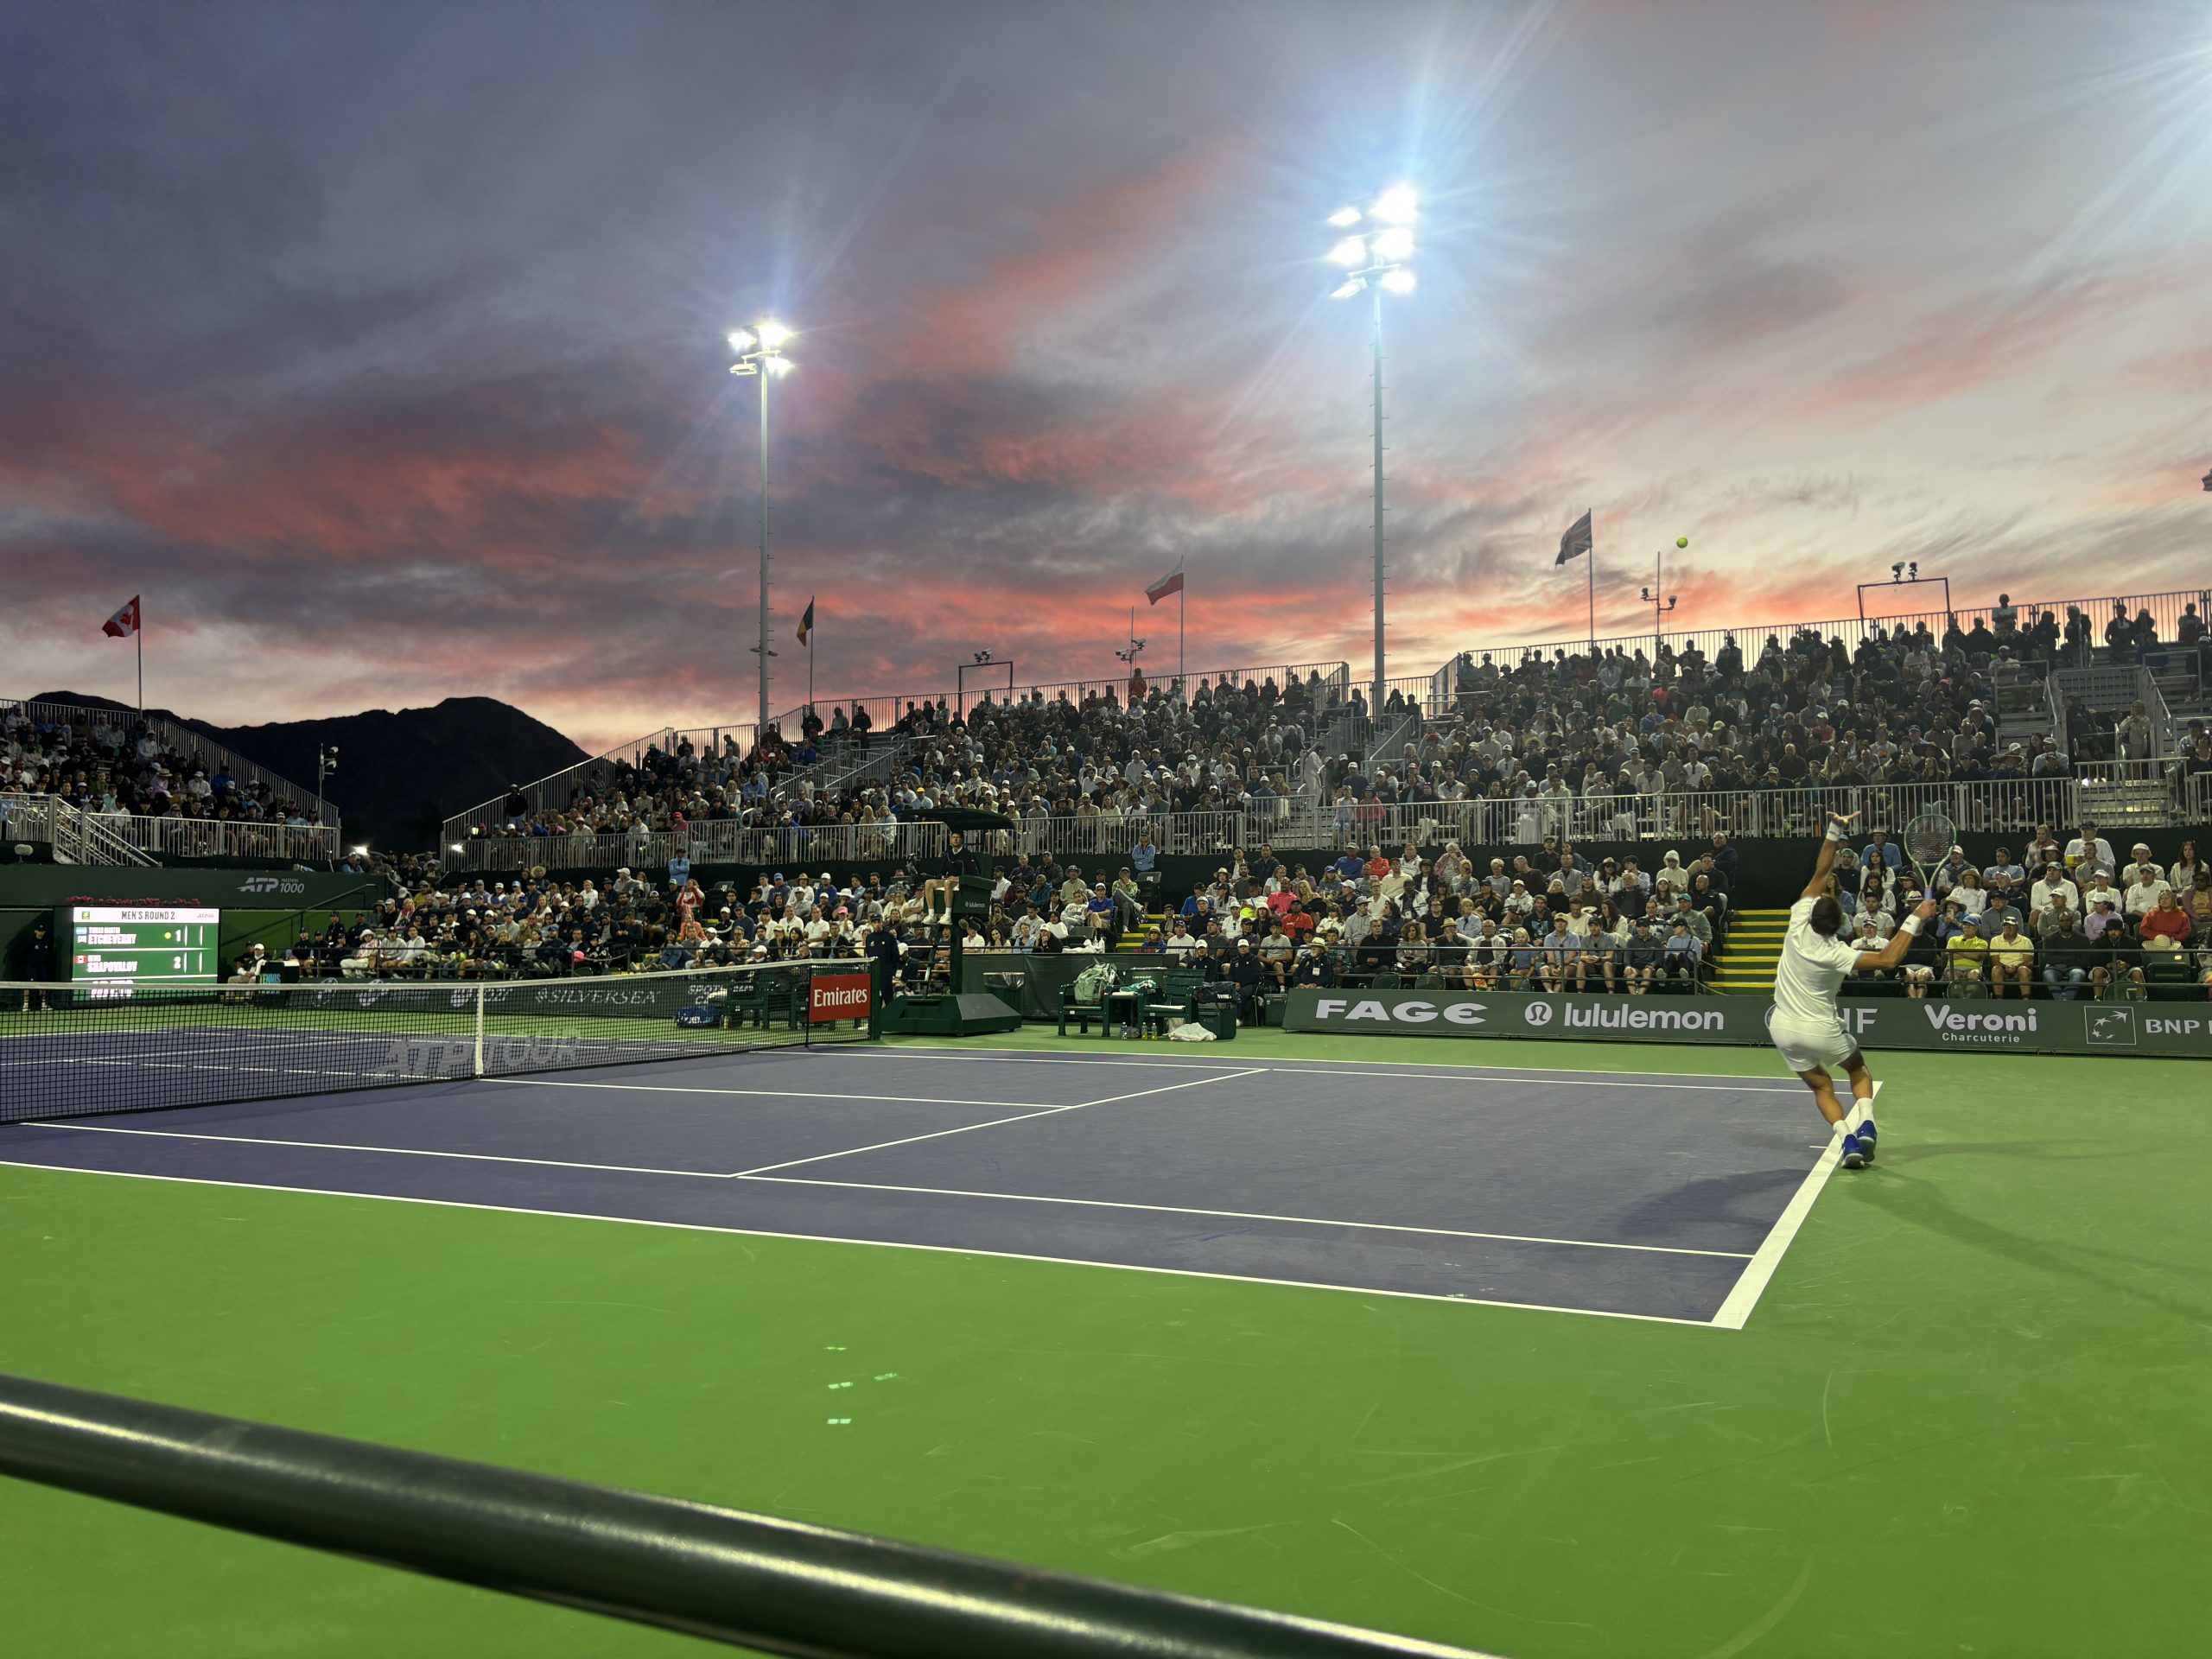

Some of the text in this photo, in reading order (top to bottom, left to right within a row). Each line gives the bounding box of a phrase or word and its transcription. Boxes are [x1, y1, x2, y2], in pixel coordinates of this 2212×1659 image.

[237, 877, 305, 893] ATP 1000
[121, 911, 175, 920] MEN'S ROUND 2
[175, 929, 181, 942] 1
[174, 956, 181, 969] 2
[548, 988, 658, 1005] SILVERSEA
[814, 987, 868, 1007] Emirates
[1315, 999, 1489, 1025] FAGE
[1563, 1002, 1725, 1030] lululemon
[1923, 1004, 2037, 1032] Veroni
[2145, 1019, 2201, 1034] BNP
[1942, 1033, 2020, 1044] Charcuterie
